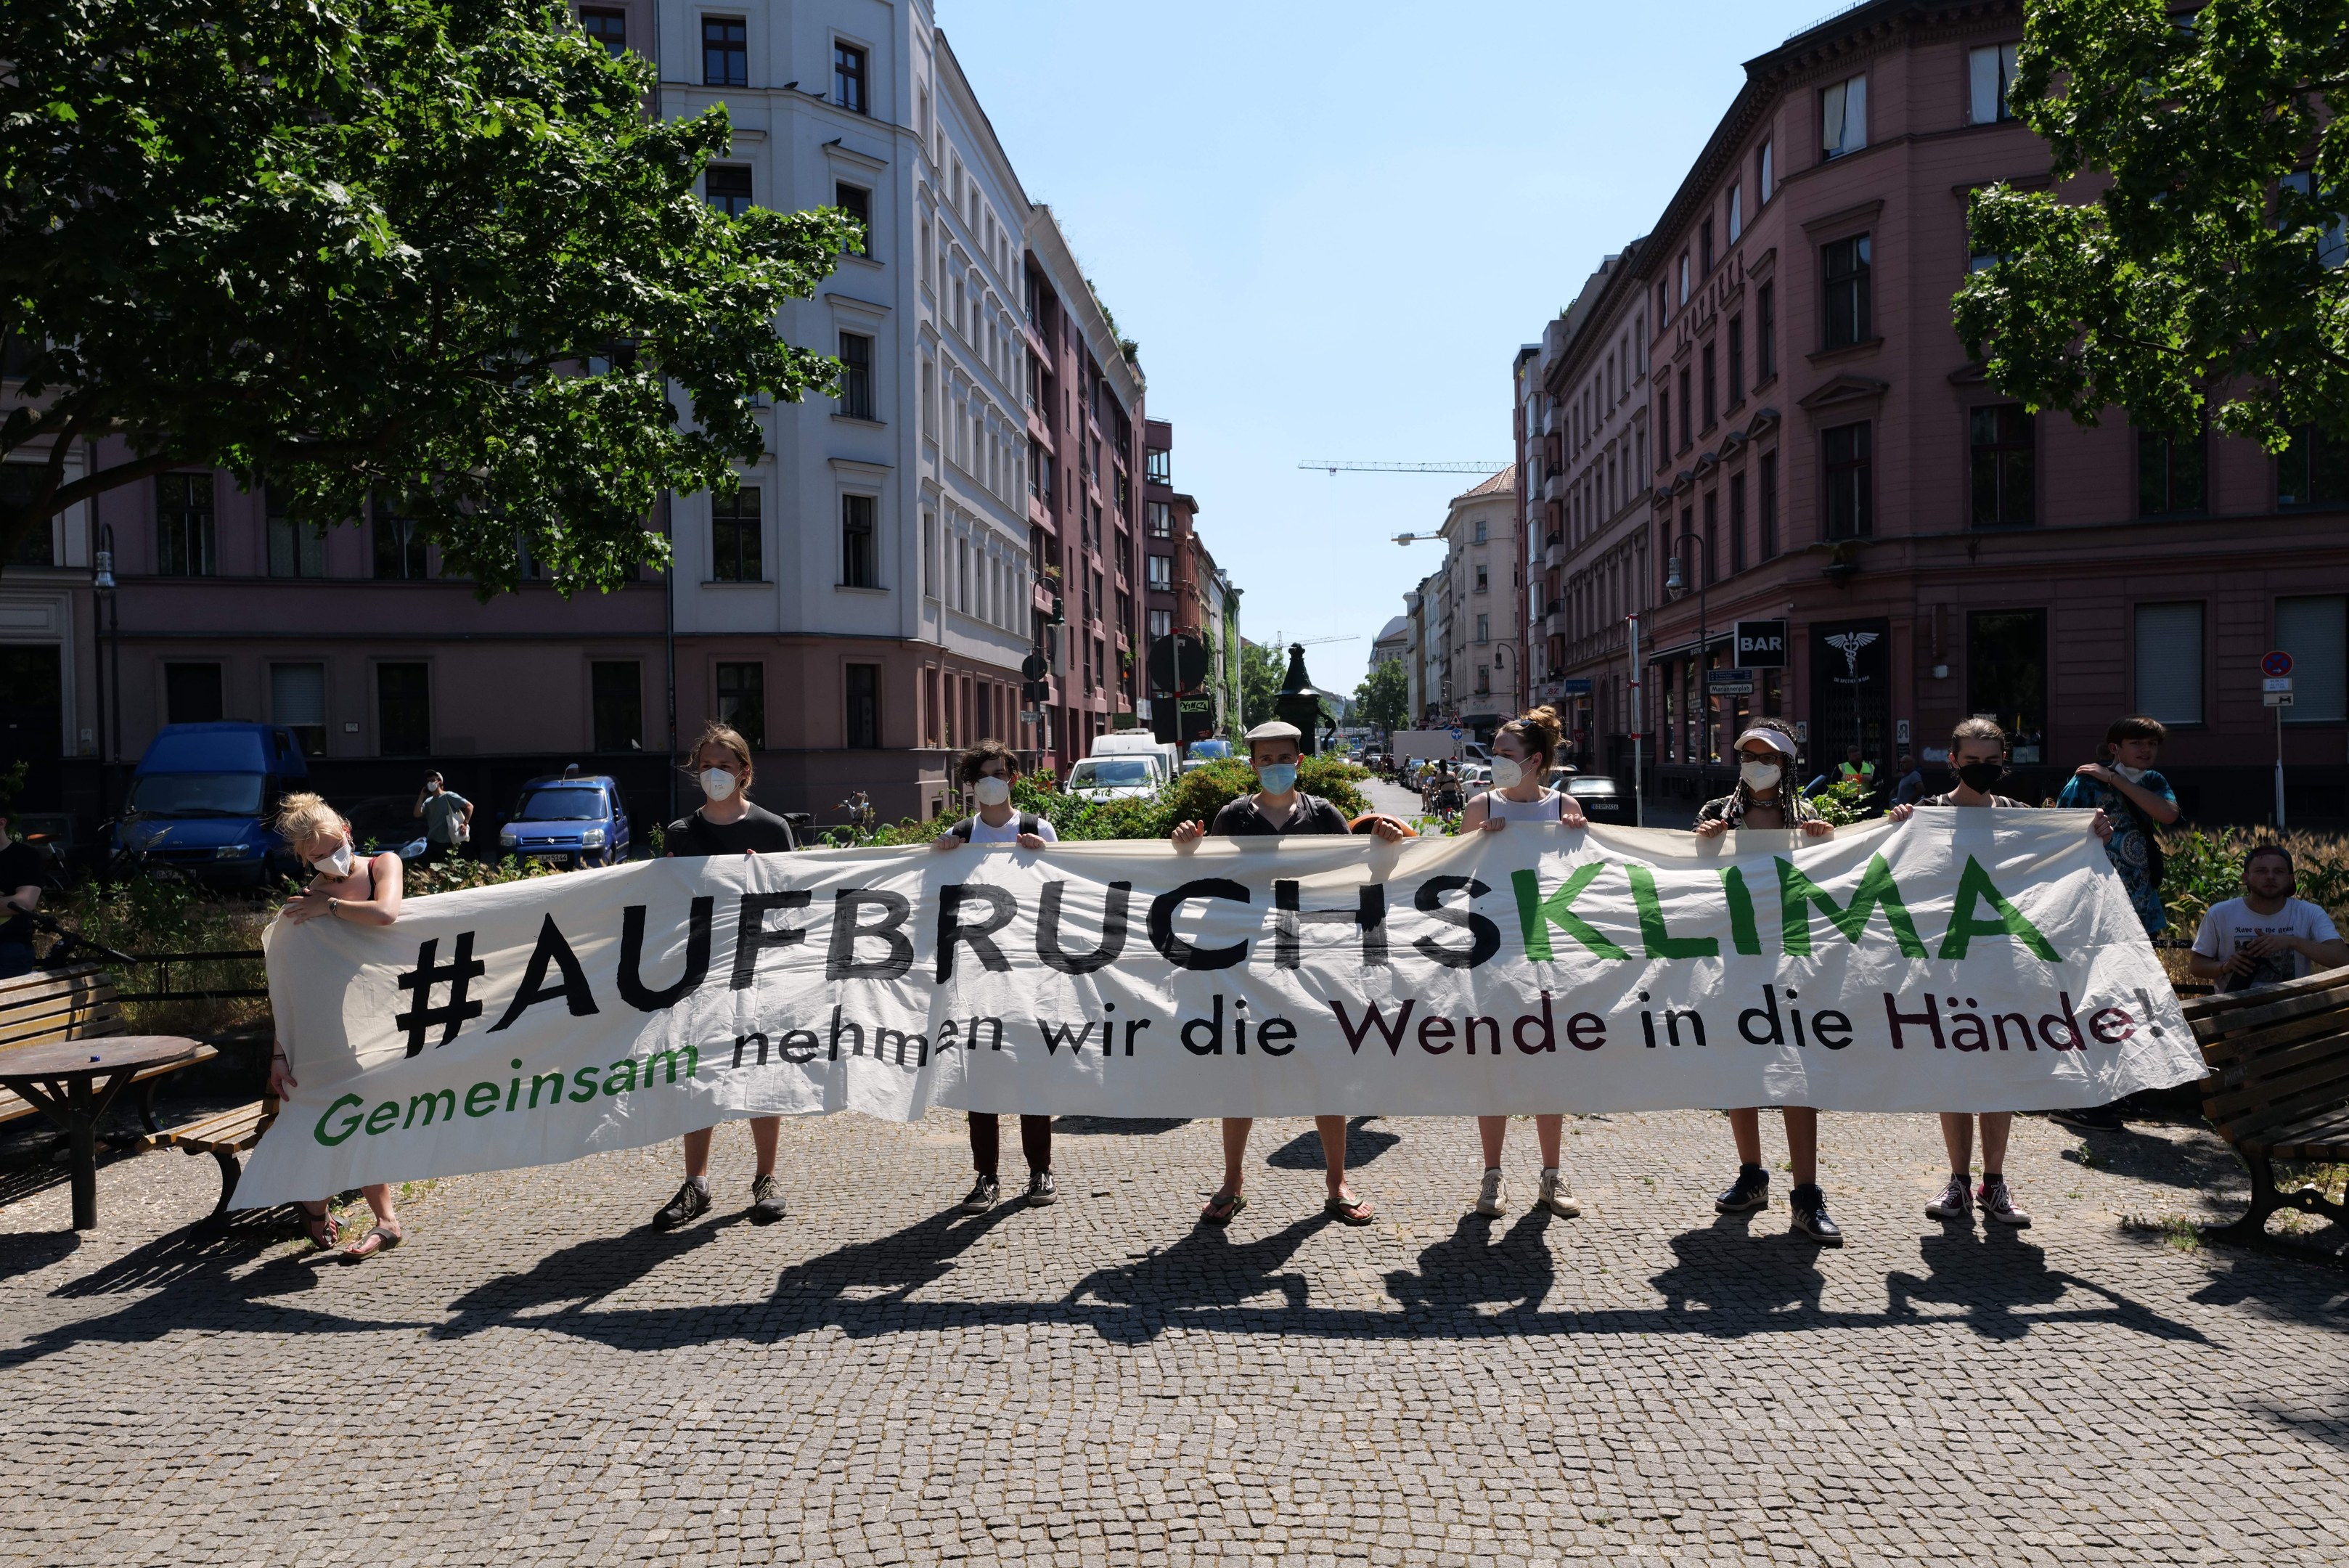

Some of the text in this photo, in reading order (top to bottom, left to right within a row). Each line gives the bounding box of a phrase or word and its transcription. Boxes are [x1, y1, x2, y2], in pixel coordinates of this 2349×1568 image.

[1741, 637, 1783, 651] BAR
[396, 852, 2063, 1059] #AUFBRUCHSKLIMA
[314, 984, 2166, 1146] Gemeinsam nehmen wir die Wende in die Hände!
